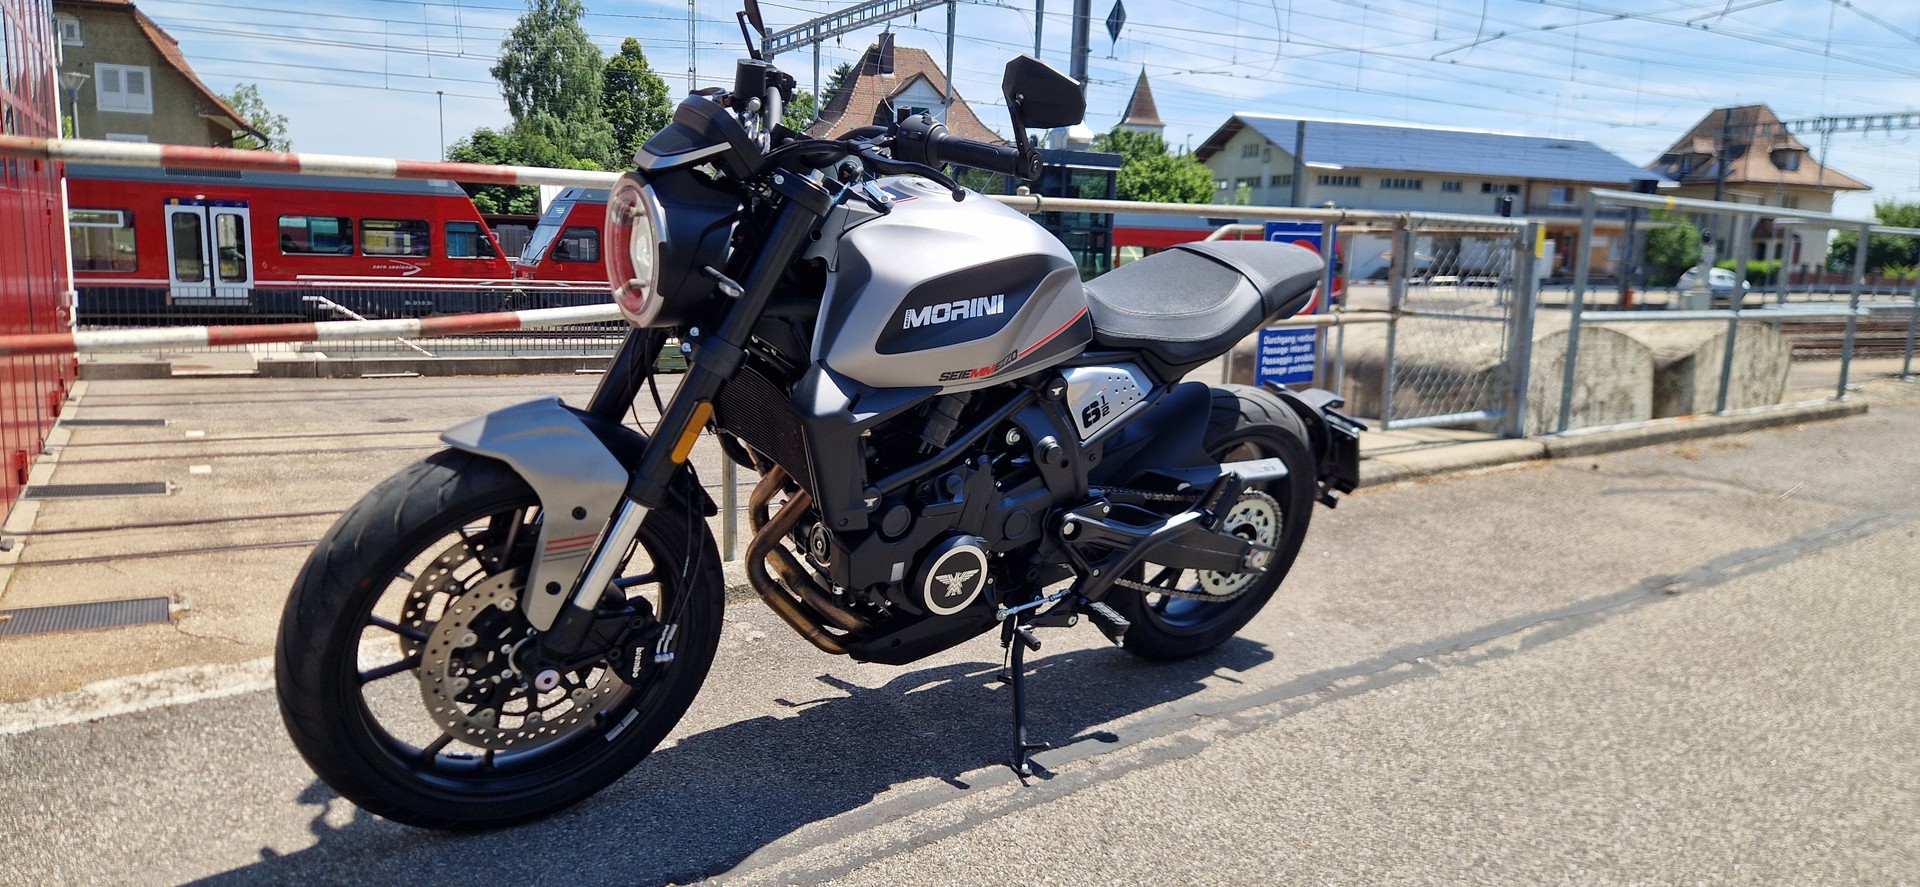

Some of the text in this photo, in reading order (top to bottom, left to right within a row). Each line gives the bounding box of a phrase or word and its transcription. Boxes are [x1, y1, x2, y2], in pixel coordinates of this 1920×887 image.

[909, 294, 1005, 328] MORINI
[1263, 335, 1296, 346] Durchgang
[1263, 346, 1288, 355] Passage
[938, 349, 1018, 381] SEIEMMEZZO
[1262, 355, 1293, 365] Passaggio
[1261, 366, 1287, 375] Passage
[632, 647, 645, 678] brembo
